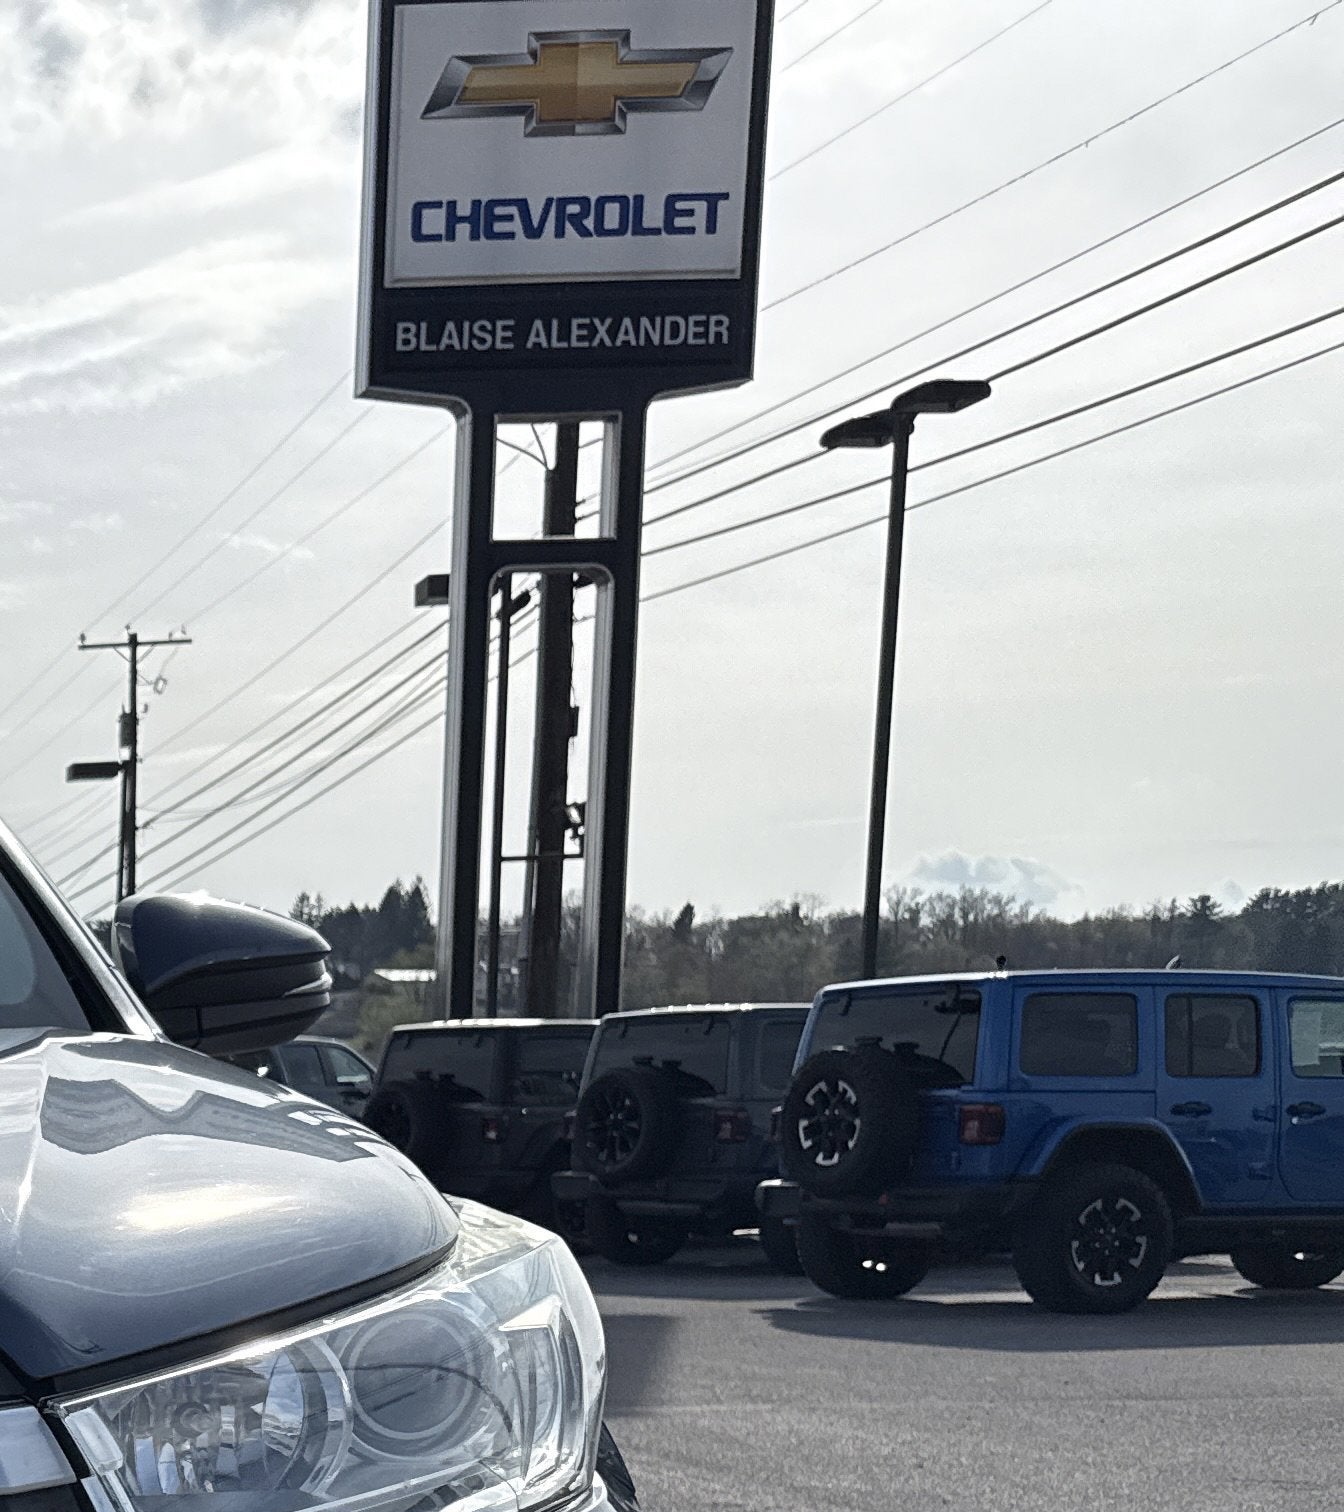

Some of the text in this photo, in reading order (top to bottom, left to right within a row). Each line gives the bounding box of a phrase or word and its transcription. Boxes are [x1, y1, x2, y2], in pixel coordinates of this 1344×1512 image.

[411, 192, 730, 243] CHEVROLET
[395, 315, 730, 352] BLAISE ALEXANDER
